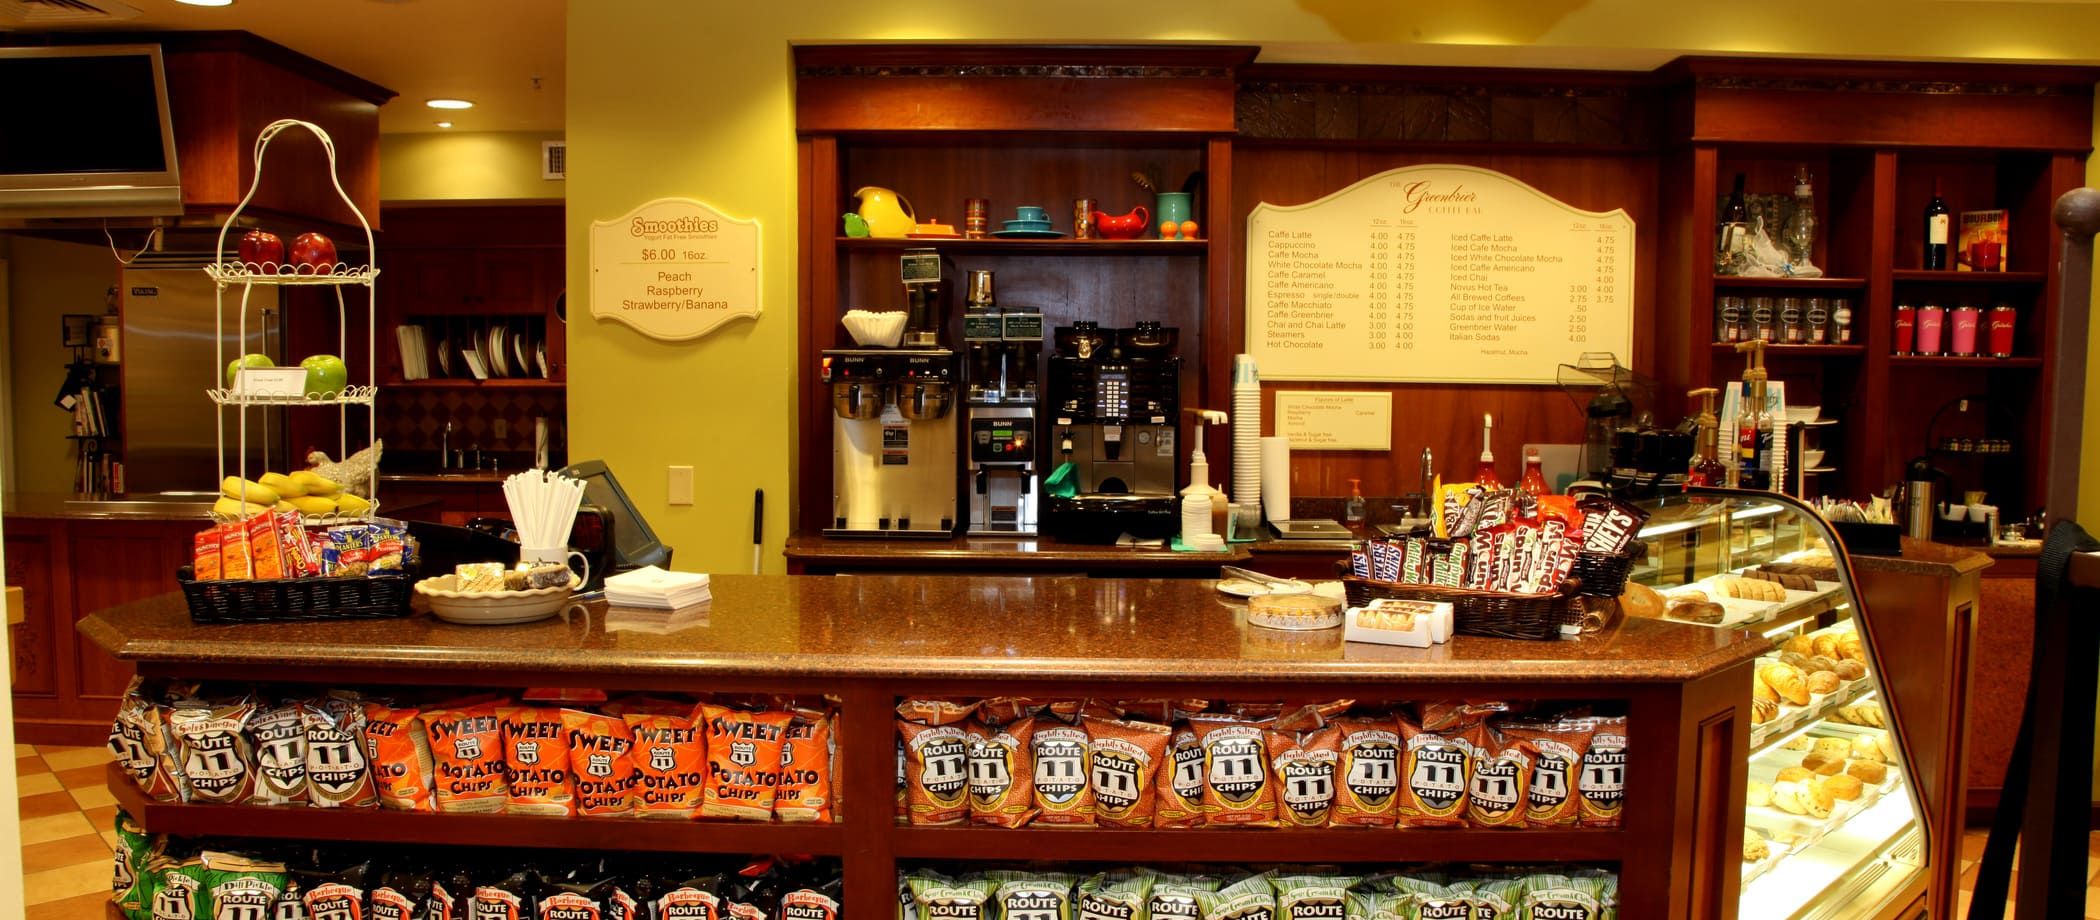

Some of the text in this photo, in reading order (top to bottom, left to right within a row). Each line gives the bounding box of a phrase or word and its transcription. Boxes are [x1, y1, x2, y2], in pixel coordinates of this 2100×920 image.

[1403, 180, 1476, 214] Greenbrier
[1962, 213, 2000, 223] BOURBON
[631, 217, 718, 237] Smoothies
[1268, 231, 1289, 239] Caffe
[1268, 241, 1315, 249] Cappuccino
[642, 249, 706, 261] $6.00 16oz.
[658, 272, 691, 281] Peach
[647, 286, 703, 297] Raspberry
[1268, 291, 1304, 300] Espresso
[622, 300, 728, 311] Strawberry/Banana
[1450, 304, 1466, 312] Cup
[1587, 509, 1633, 552] SHEY'S
[430, 716, 498, 741] SWEET
[501, 718, 562, 740] SWEET
[632, 724, 698, 744] SWEET
[712, 718, 782, 741] SWEET
[1236, 729, 1261, 737] Salted
[314, 746, 351, 764] 11
[1038, 746, 1081, 757] ROUTE
[1212, 744, 1257, 755] ROUTE
[195, 752, 230, 772] 11
[1218, 758, 1252, 775] 11
[442, 760, 506, 780] POTATO
[710, 761, 776, 786] POTATO
[1042, 761, 1075, 777] 11
[313, 771, 357, 781] CHIPS
[506, 767, 564, 783] POTATO
[634, 767, 700, 789] POTATO
[192, 776, 238, 787] CHIPS
[451, 780, 492, 794] CHIPS
[1216, 782, 1257, 792] CHIPS
[510, 786, 548, 797] CHIPS
[718, 786, 760, 800] CHIPS
[1039, 784, 1077, 793] CHIPS
[644, 790, 685, 804] CHIPS
[224, 879, 273, 891] Dill Pickle
[222, 895, 266, 904] ROUTE
[668, 893, 710, 901] Barbeque
[1007, 898, 1057, 908] ROUTE
[669, 906, 706, 916] ROUTE
